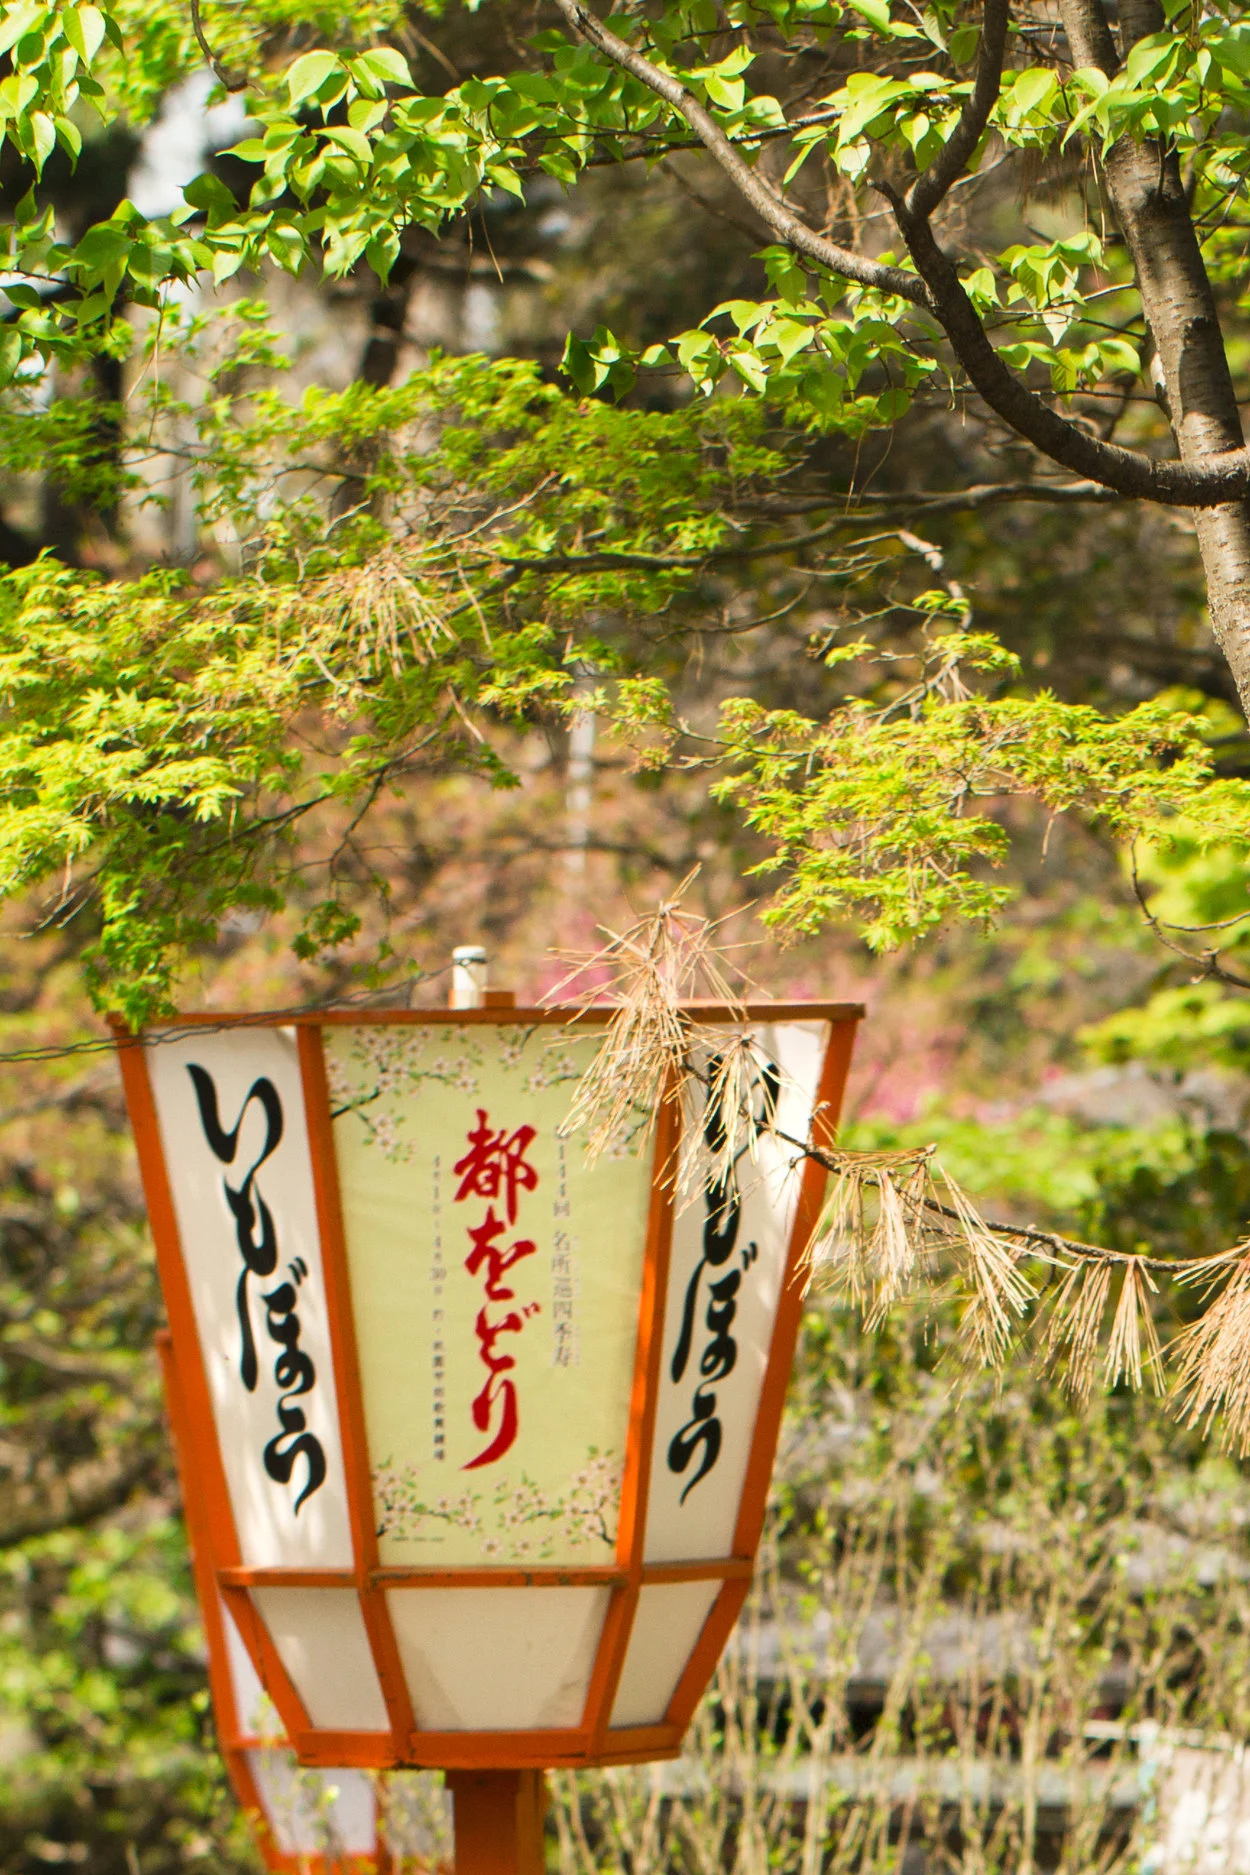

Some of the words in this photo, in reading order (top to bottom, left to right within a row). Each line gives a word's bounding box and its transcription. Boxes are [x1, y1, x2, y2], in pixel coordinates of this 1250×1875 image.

[186, 1063, 327, 1518] いもぼう
[453, 1107, 542, 1471] 都をどり
